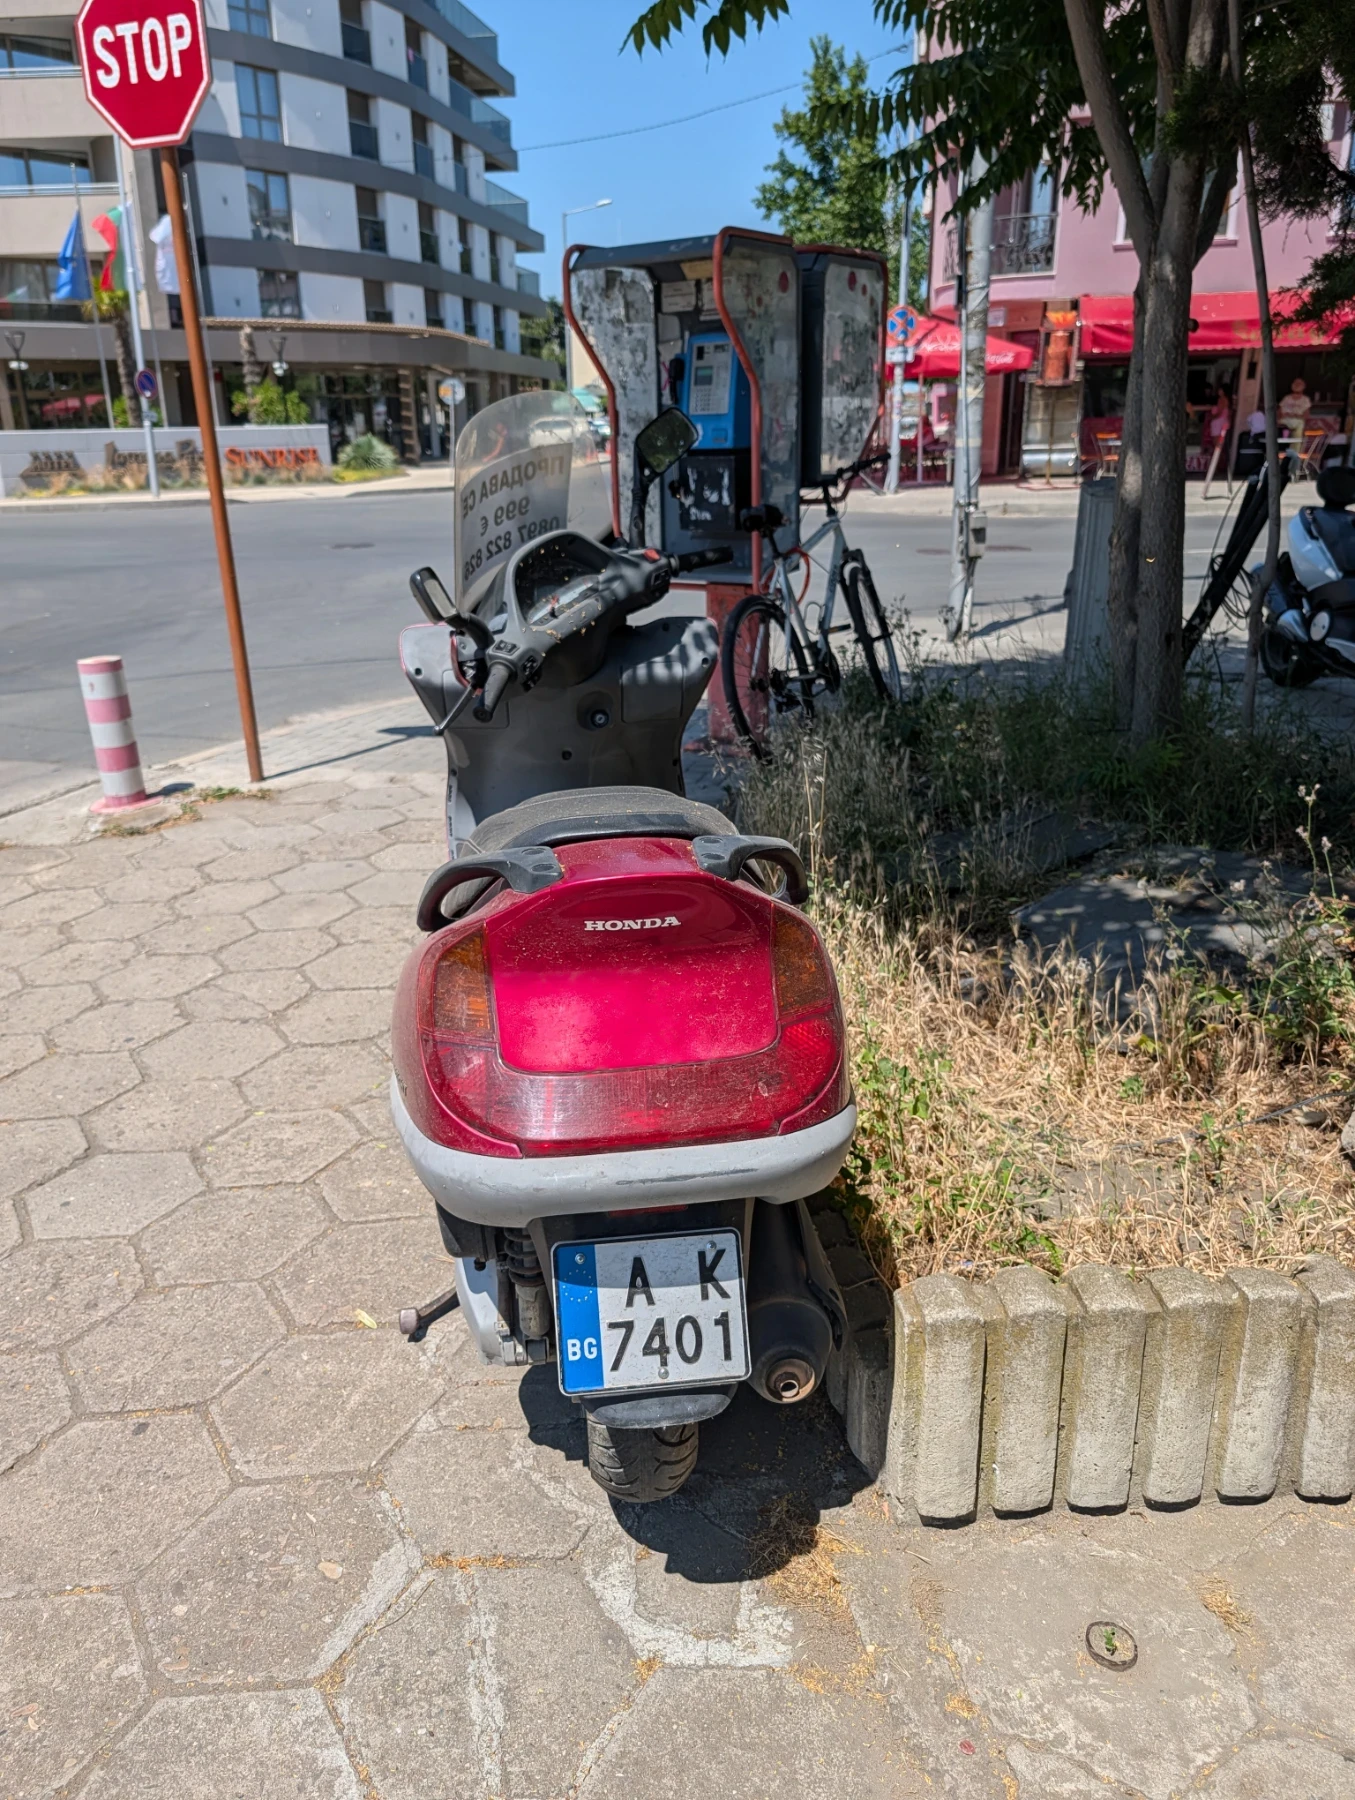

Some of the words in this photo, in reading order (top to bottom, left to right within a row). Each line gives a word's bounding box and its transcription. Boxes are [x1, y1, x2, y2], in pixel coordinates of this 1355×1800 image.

[93, 13, 192, 89] STOP
[225, 446, 319, 470] SUNRISE
[584, 916, 681, 931] HONDA
[625, 1256, 656, 1308] A
[697, 1248, 731, 1302] K
[567, 1337, 598, 1361] BG
[606, 1311, 732, 1372] 7401
